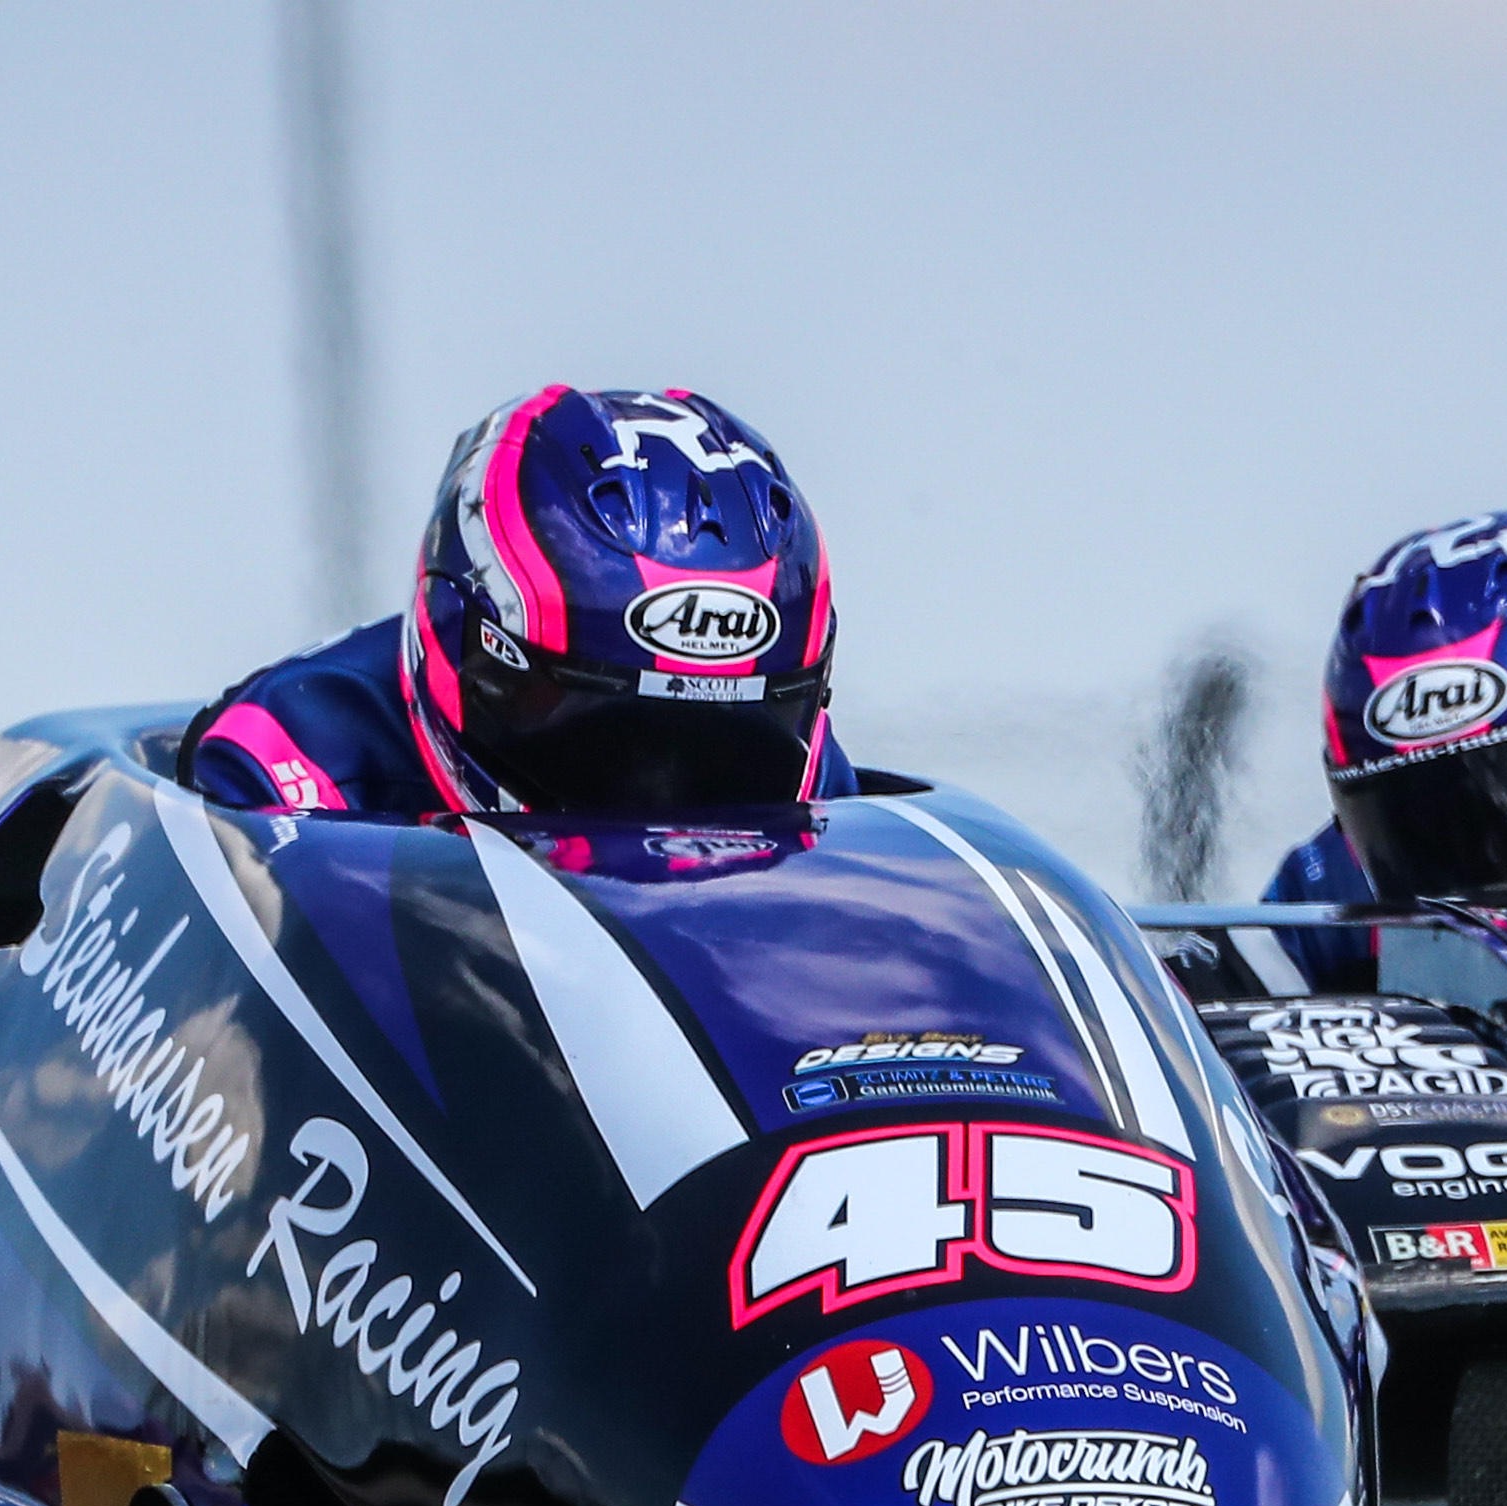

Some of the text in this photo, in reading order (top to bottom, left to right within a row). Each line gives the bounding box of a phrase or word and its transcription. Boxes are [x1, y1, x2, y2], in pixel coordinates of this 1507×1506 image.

[646, 592, 762, 639] Arai
[685, 678, 741, 692] SCOTT
[1377, 669, 1482, 725] Arai
[20, 821, 251, 1222] Steinhausen
[1265, 1025, 1422, 1048] NGK
[795, 1041, 1025, 1074] DESIGNS
[748, 1132, 1178, 1302] 45
[1384, 1230, 1479, 1261] B&R
[941, 1324, 1238, 1405] Wilbers
[961, 1381, 1248, 1435] Performance Suspension
